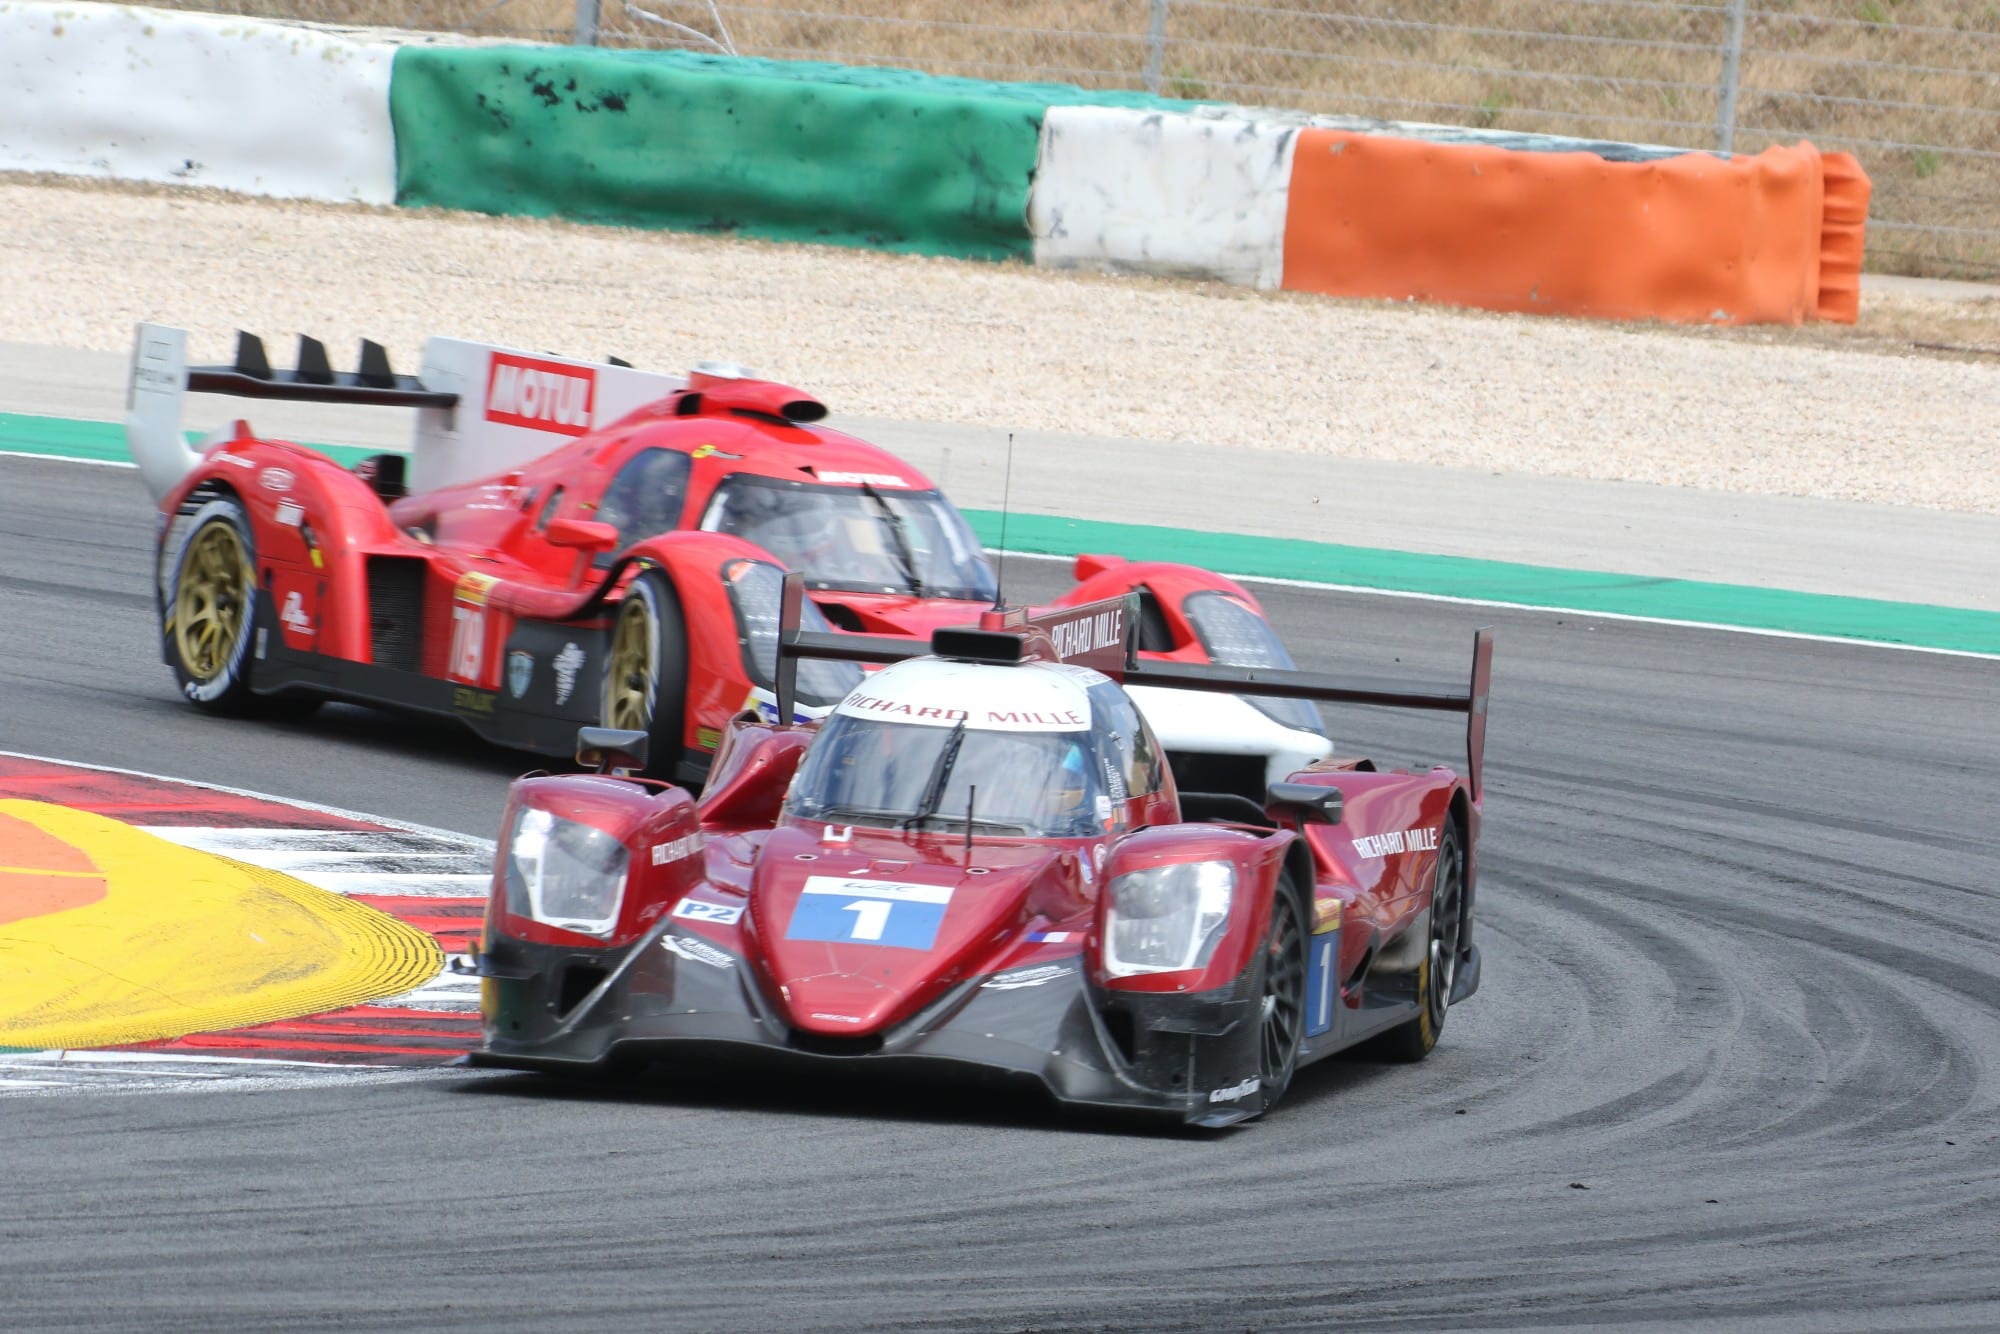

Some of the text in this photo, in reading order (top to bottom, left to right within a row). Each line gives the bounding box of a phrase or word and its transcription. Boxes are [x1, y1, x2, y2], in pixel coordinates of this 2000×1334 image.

[489, 363, 593, 428] MOTUL
[1052, 609, 1122, 659] RICHARD MILLE
[846, 692, 1086, 725] RICHARD MILLE
[1352, 827, 1438, 859] RICHARD MILLE
[681, 902, 735, 921] P2
[841, 899, 894, 941] 1
[1319, 942, 1332, 1026] 1
